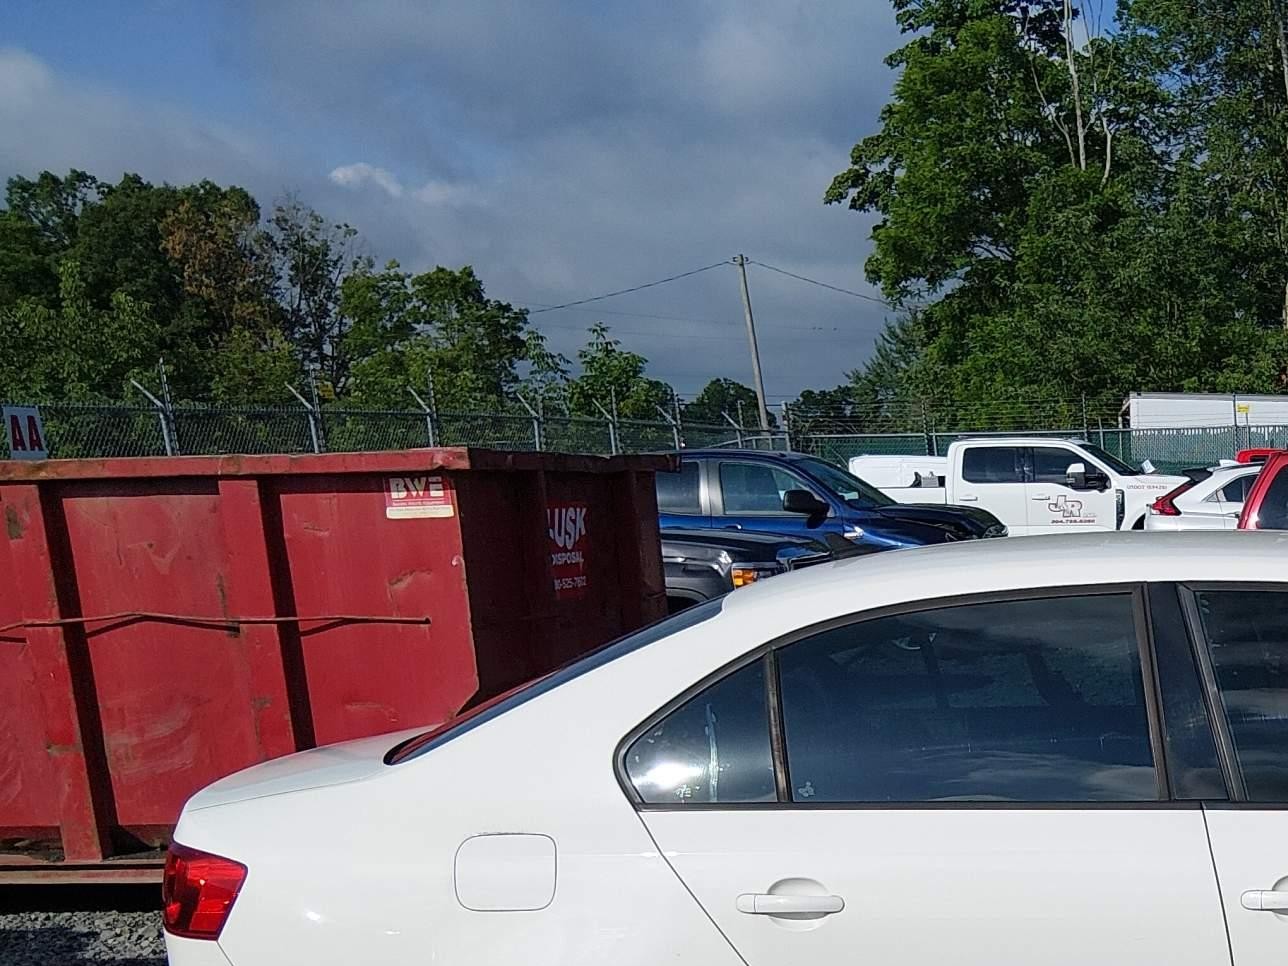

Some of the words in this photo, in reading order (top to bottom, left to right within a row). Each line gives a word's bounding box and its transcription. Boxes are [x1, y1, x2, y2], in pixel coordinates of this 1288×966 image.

[11, 415, 44, 451] AA
[389, 476, 444, 499] BWE
[546, 506, 588, 550] LUSK
